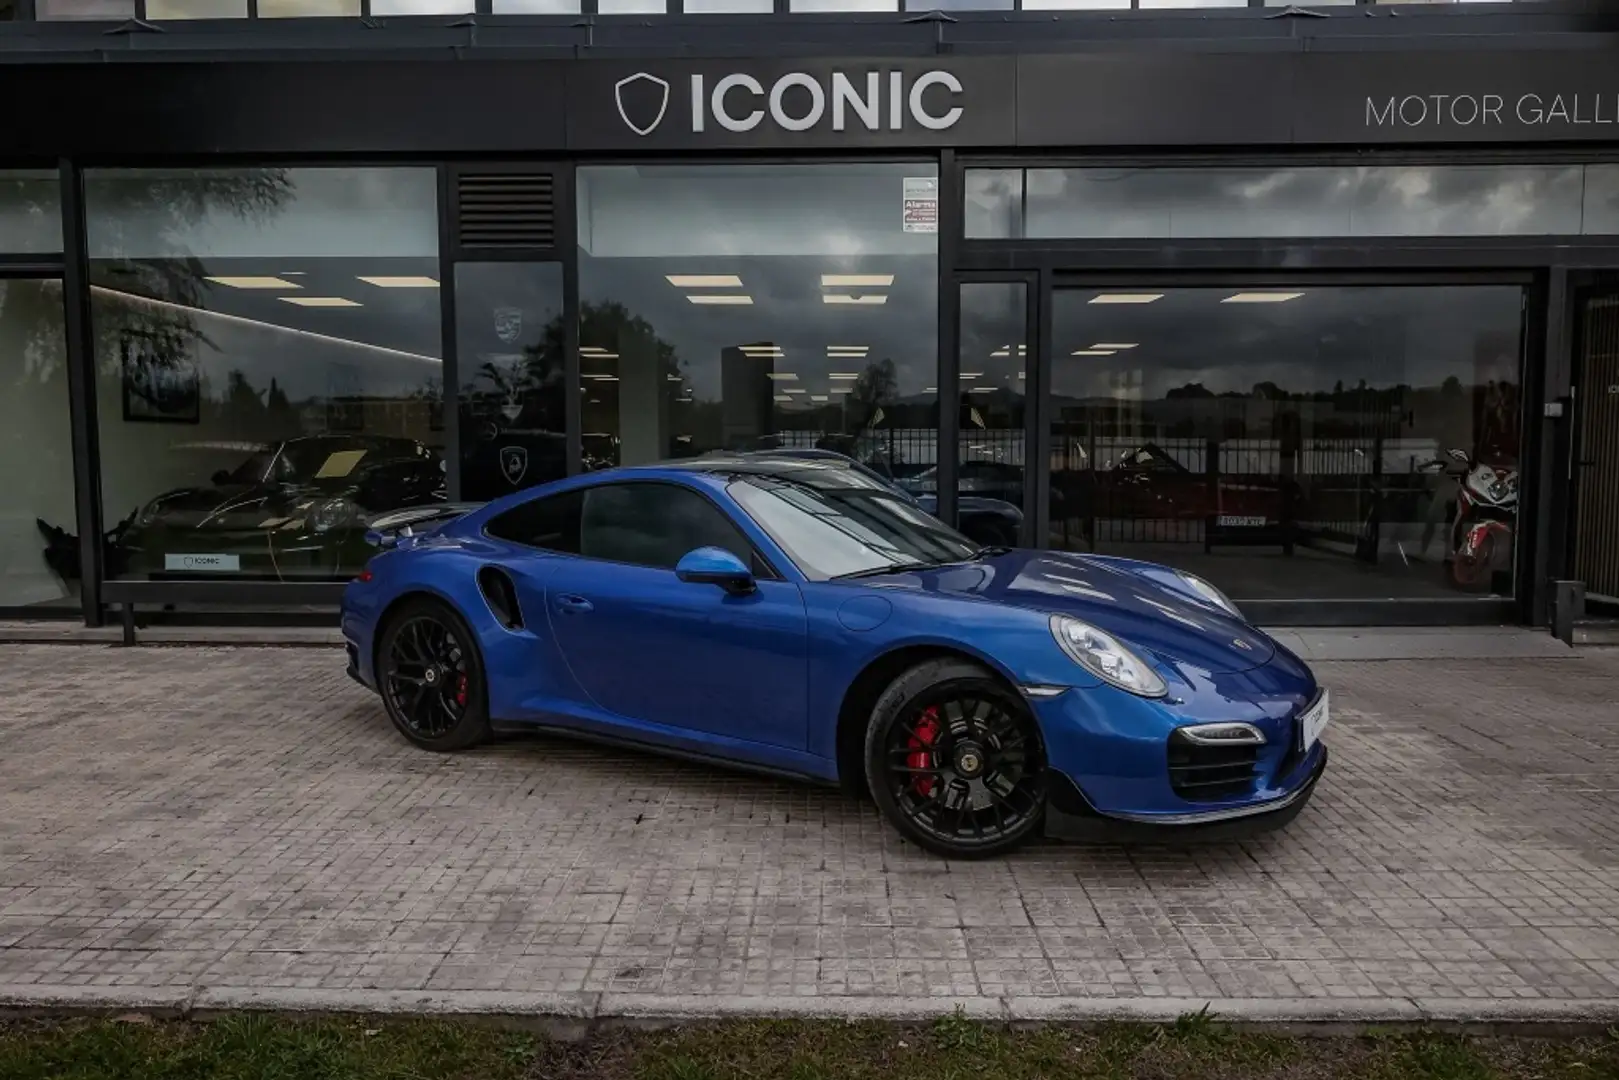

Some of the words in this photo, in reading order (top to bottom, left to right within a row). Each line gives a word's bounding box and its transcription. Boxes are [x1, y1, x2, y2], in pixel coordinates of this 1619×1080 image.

[691, 71, 964, 132] ICONIC
[1365, 94, 1504, 126] MOTOR
[1515, 93, 1619, 124] GALL
